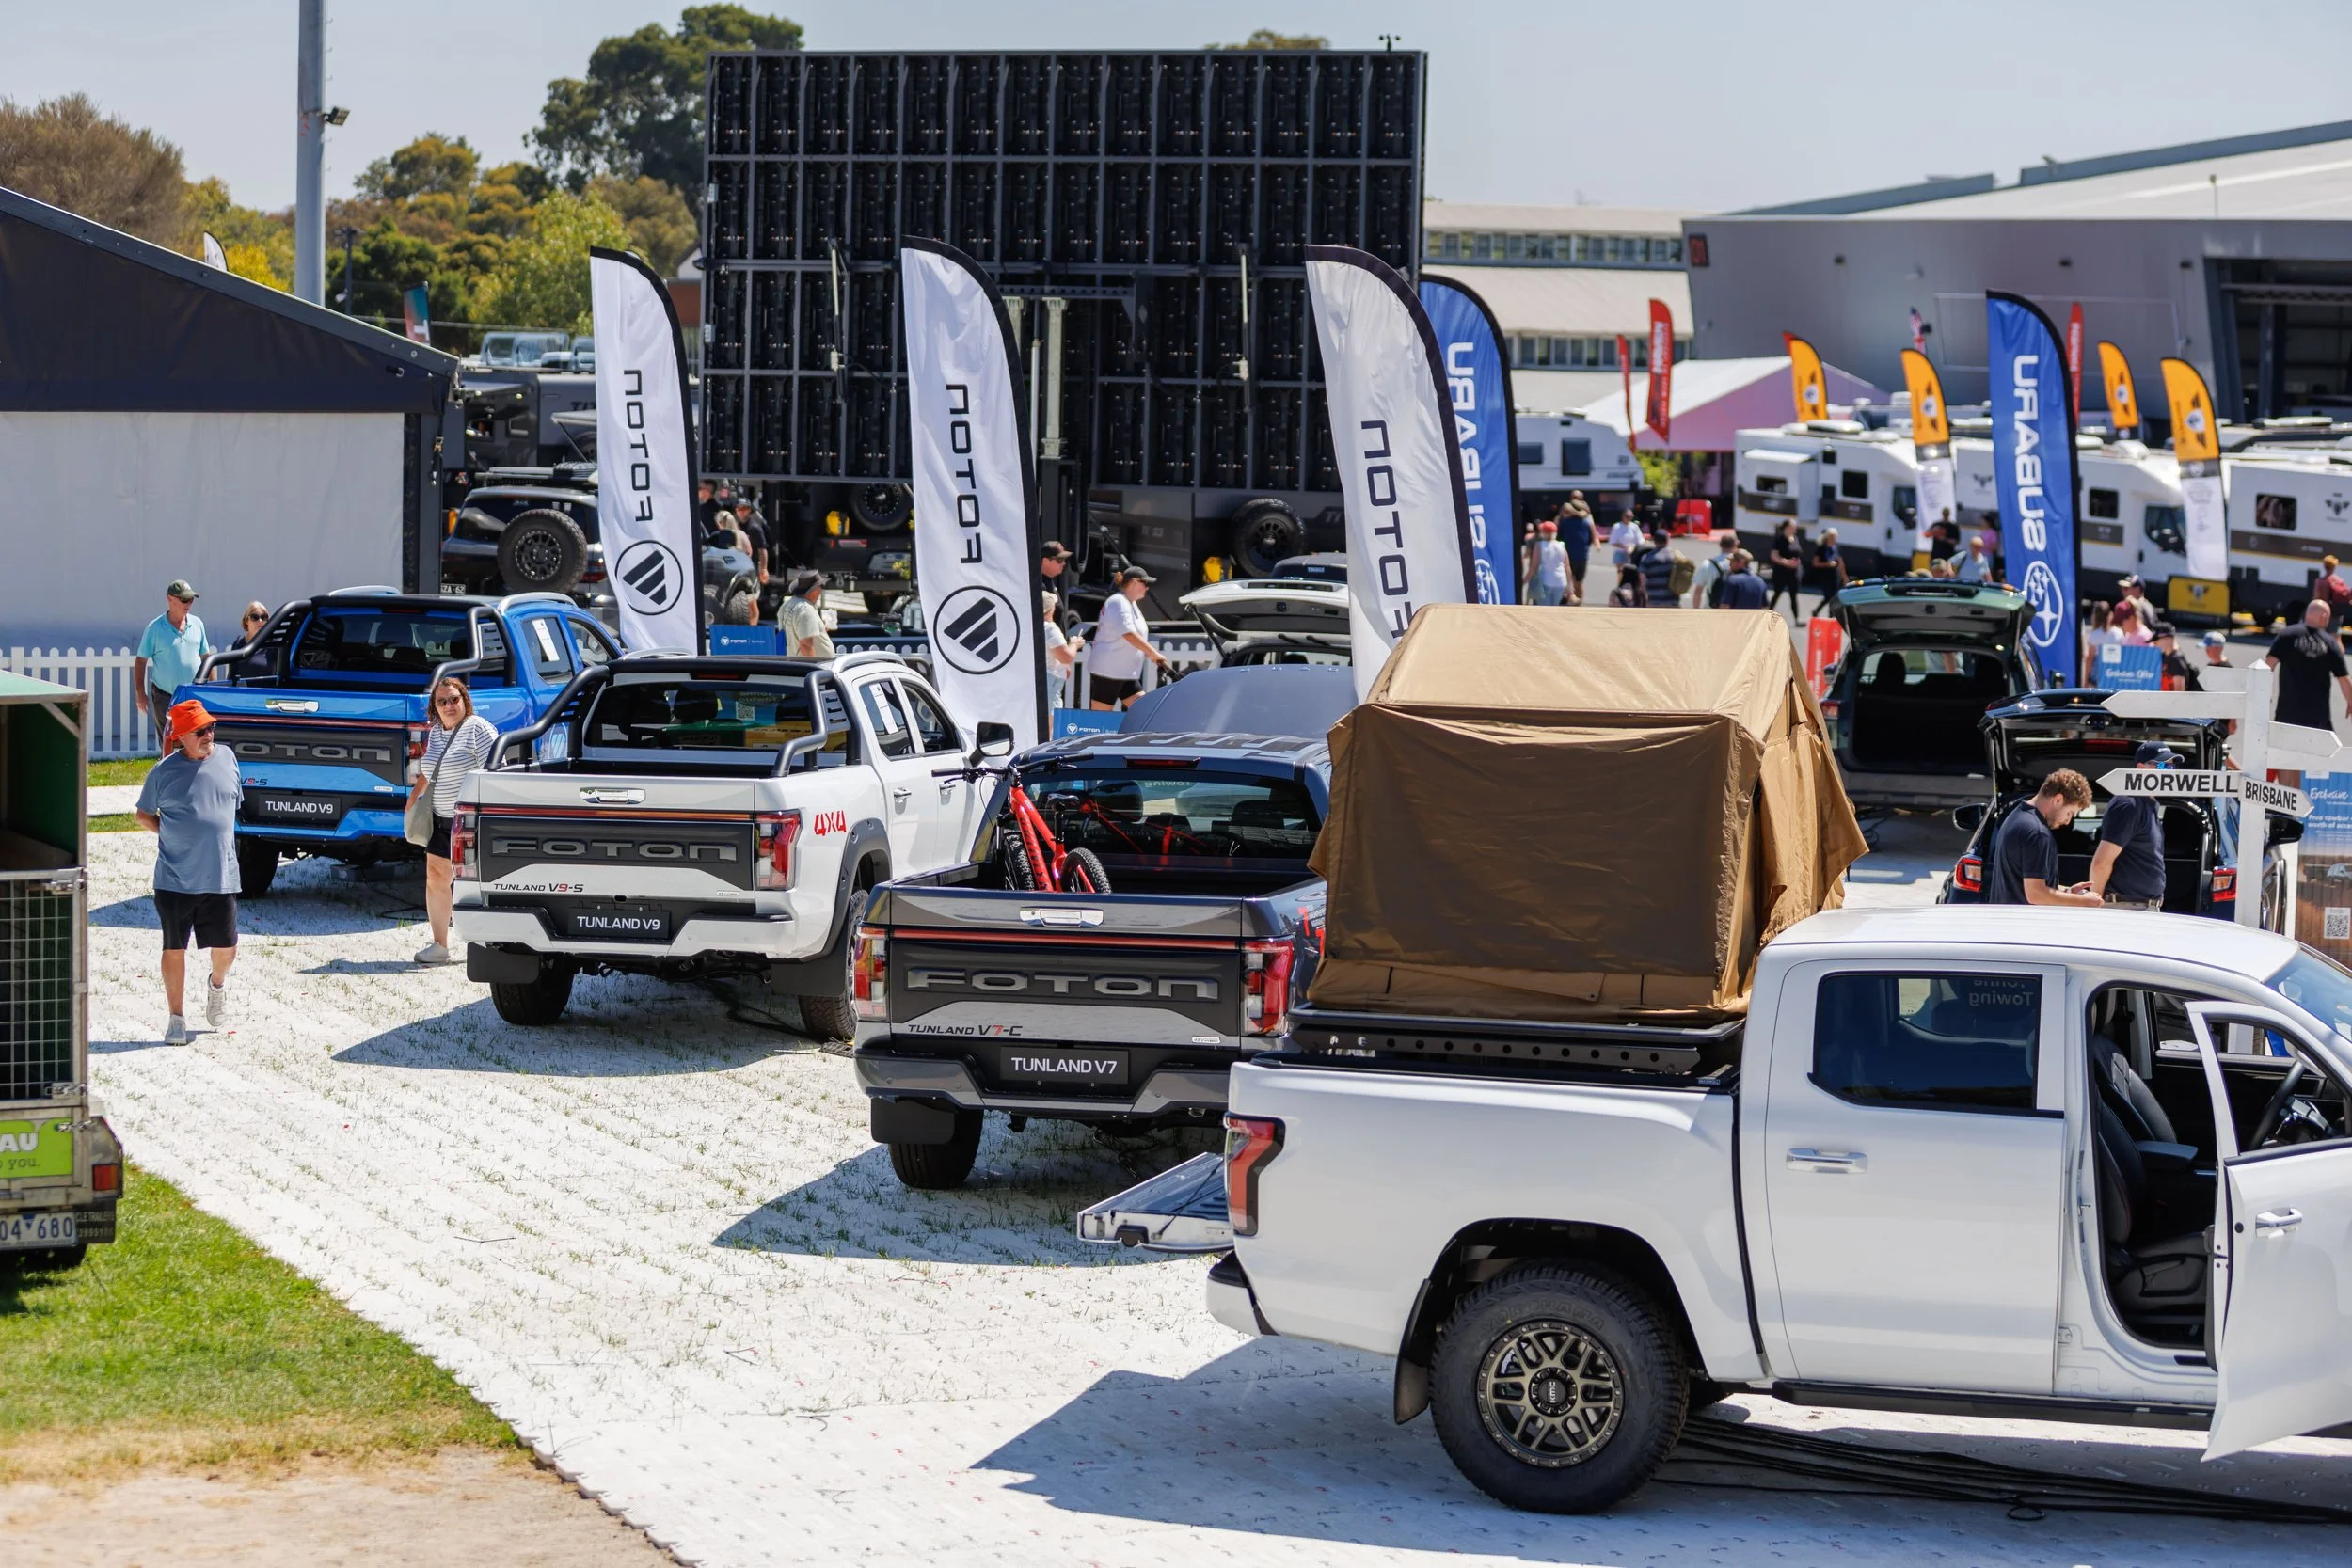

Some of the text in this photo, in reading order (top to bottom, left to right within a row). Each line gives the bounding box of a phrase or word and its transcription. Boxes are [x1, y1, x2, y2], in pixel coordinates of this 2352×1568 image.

[2124, 773, 2238, 794] MORWELL
[2245, 781, 2297, 812] BRISBANE
[2310, 787, 2349, 800] Exclusive
[265, 800, 334, 814] TUNLAND V9
[492, 837, 738, 863] FOTON
[494, 883, 584, 893] TUNLAND V9-S
[577, 916, 660, 930] TUNLAND V9
[907, 967, 1219, 1000] FOTON
[908, 1024, 1023, 1037] TUNLAND V7-C
[1011, 1057, 1118, 1075] TUNLAND V7
[8, 1158, 40, 1170] you.
[37, 1217, 72, 1239] 680
